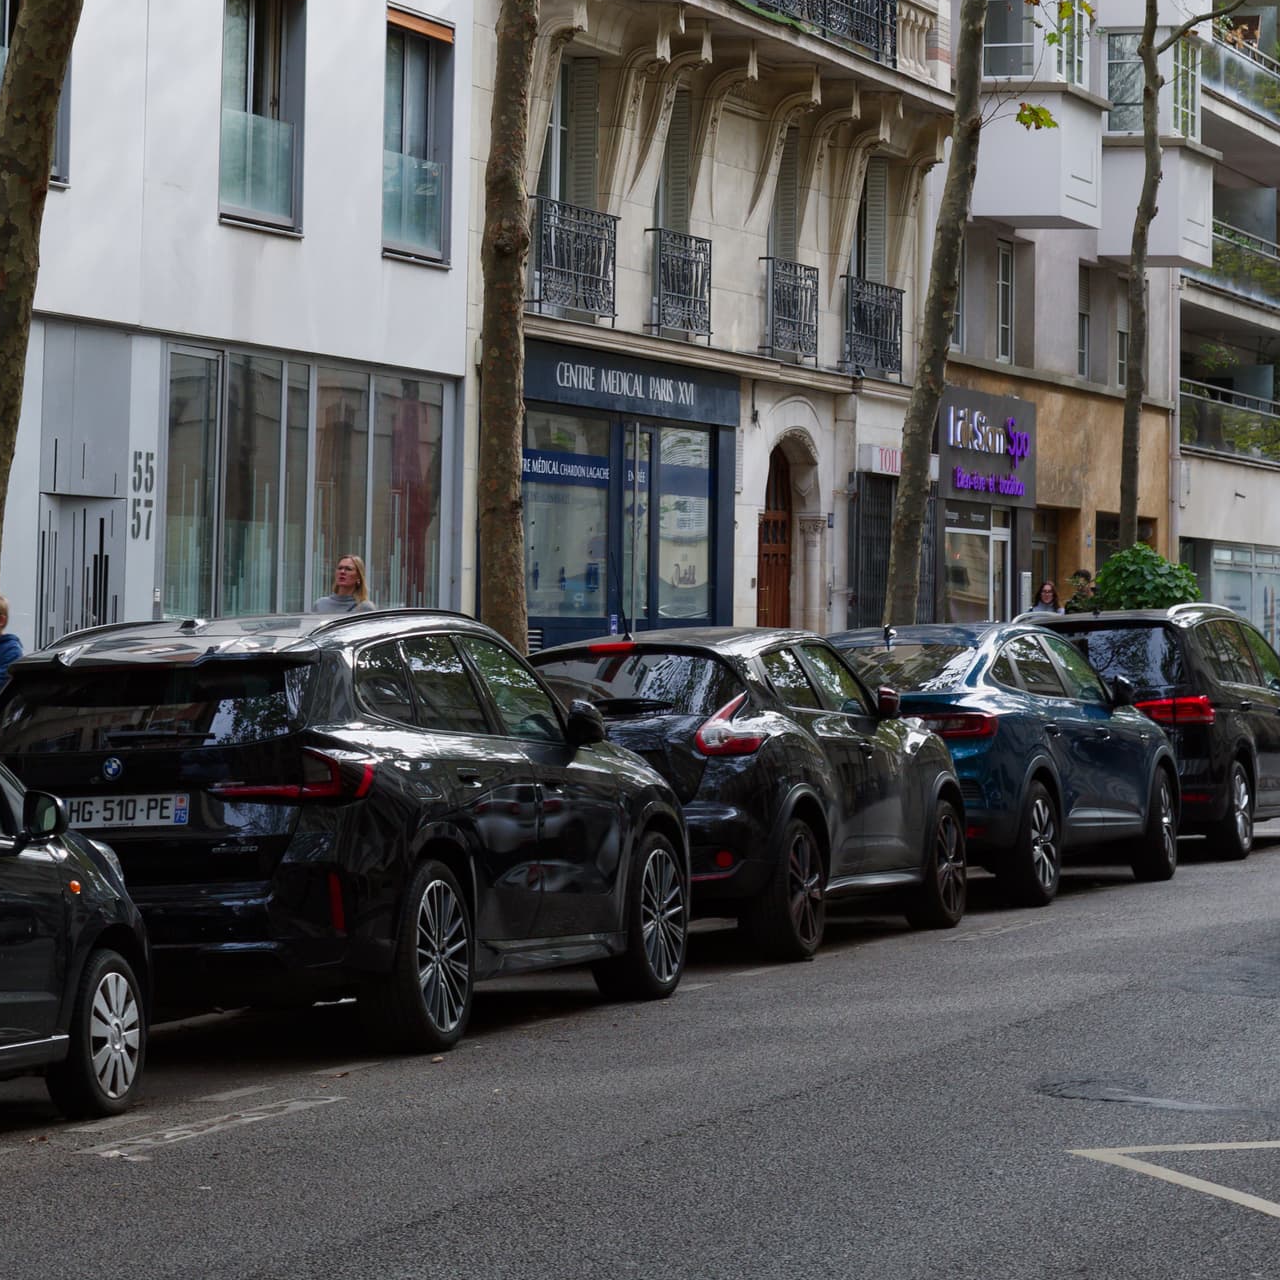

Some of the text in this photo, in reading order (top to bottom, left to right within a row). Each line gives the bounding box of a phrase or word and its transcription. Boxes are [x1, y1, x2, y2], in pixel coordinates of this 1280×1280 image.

[556, 361, 695, 405] CENTRE MEDICAL PARIS XVI
[1006, 416, 1031, 470] Spa
[132, 451, 154, 493] 55
[531, 456, 559, 475] MÉDICAL
[559, 463, 586, 478] CHARDON
[586, 466, 609, 480] LAGACHE
[131, 498, 153, 541] 57
[174, 810, 187, 823] 75
